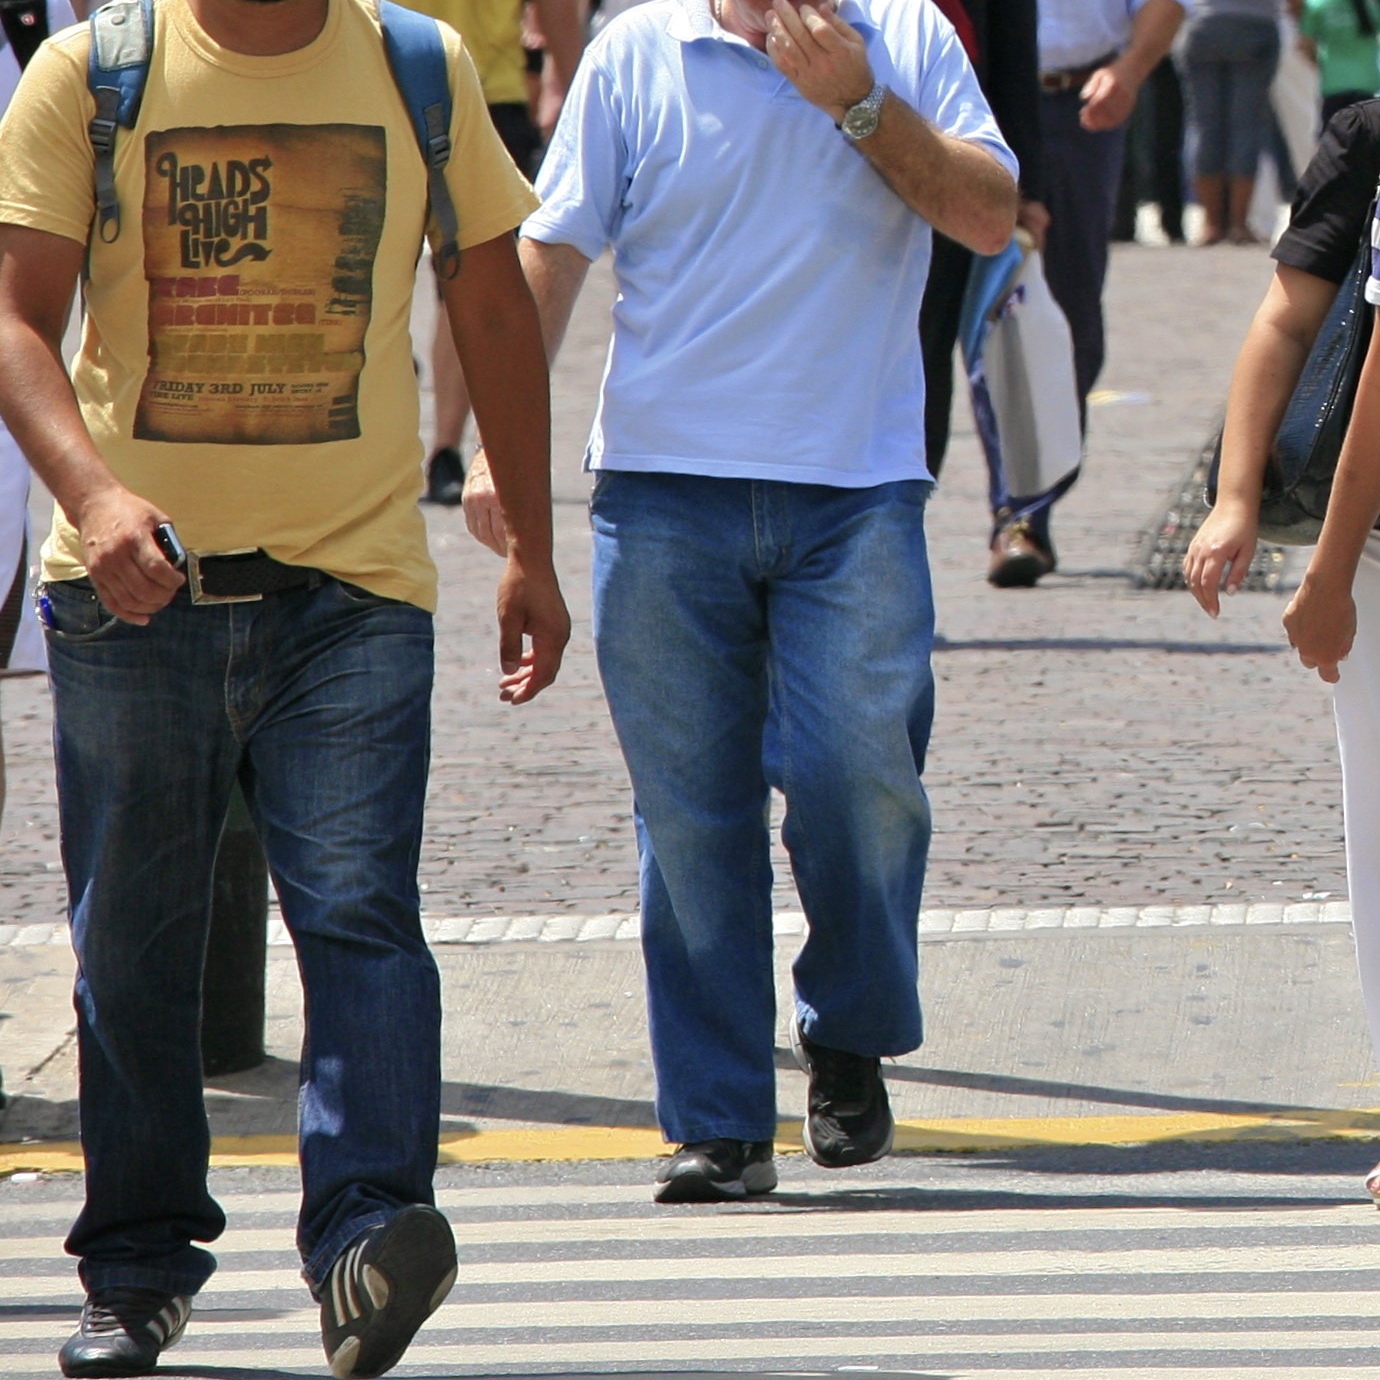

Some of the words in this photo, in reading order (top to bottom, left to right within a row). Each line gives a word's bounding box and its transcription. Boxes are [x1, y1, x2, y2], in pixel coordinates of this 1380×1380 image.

[156, 152, 274, 225] HEADS
[177, 198, 269, 241] HIGH
[153, 380, 206, 394] FRIDAY
[208, 382, 244, 395] 3RD
[249, 382, 287, 397] JULY
